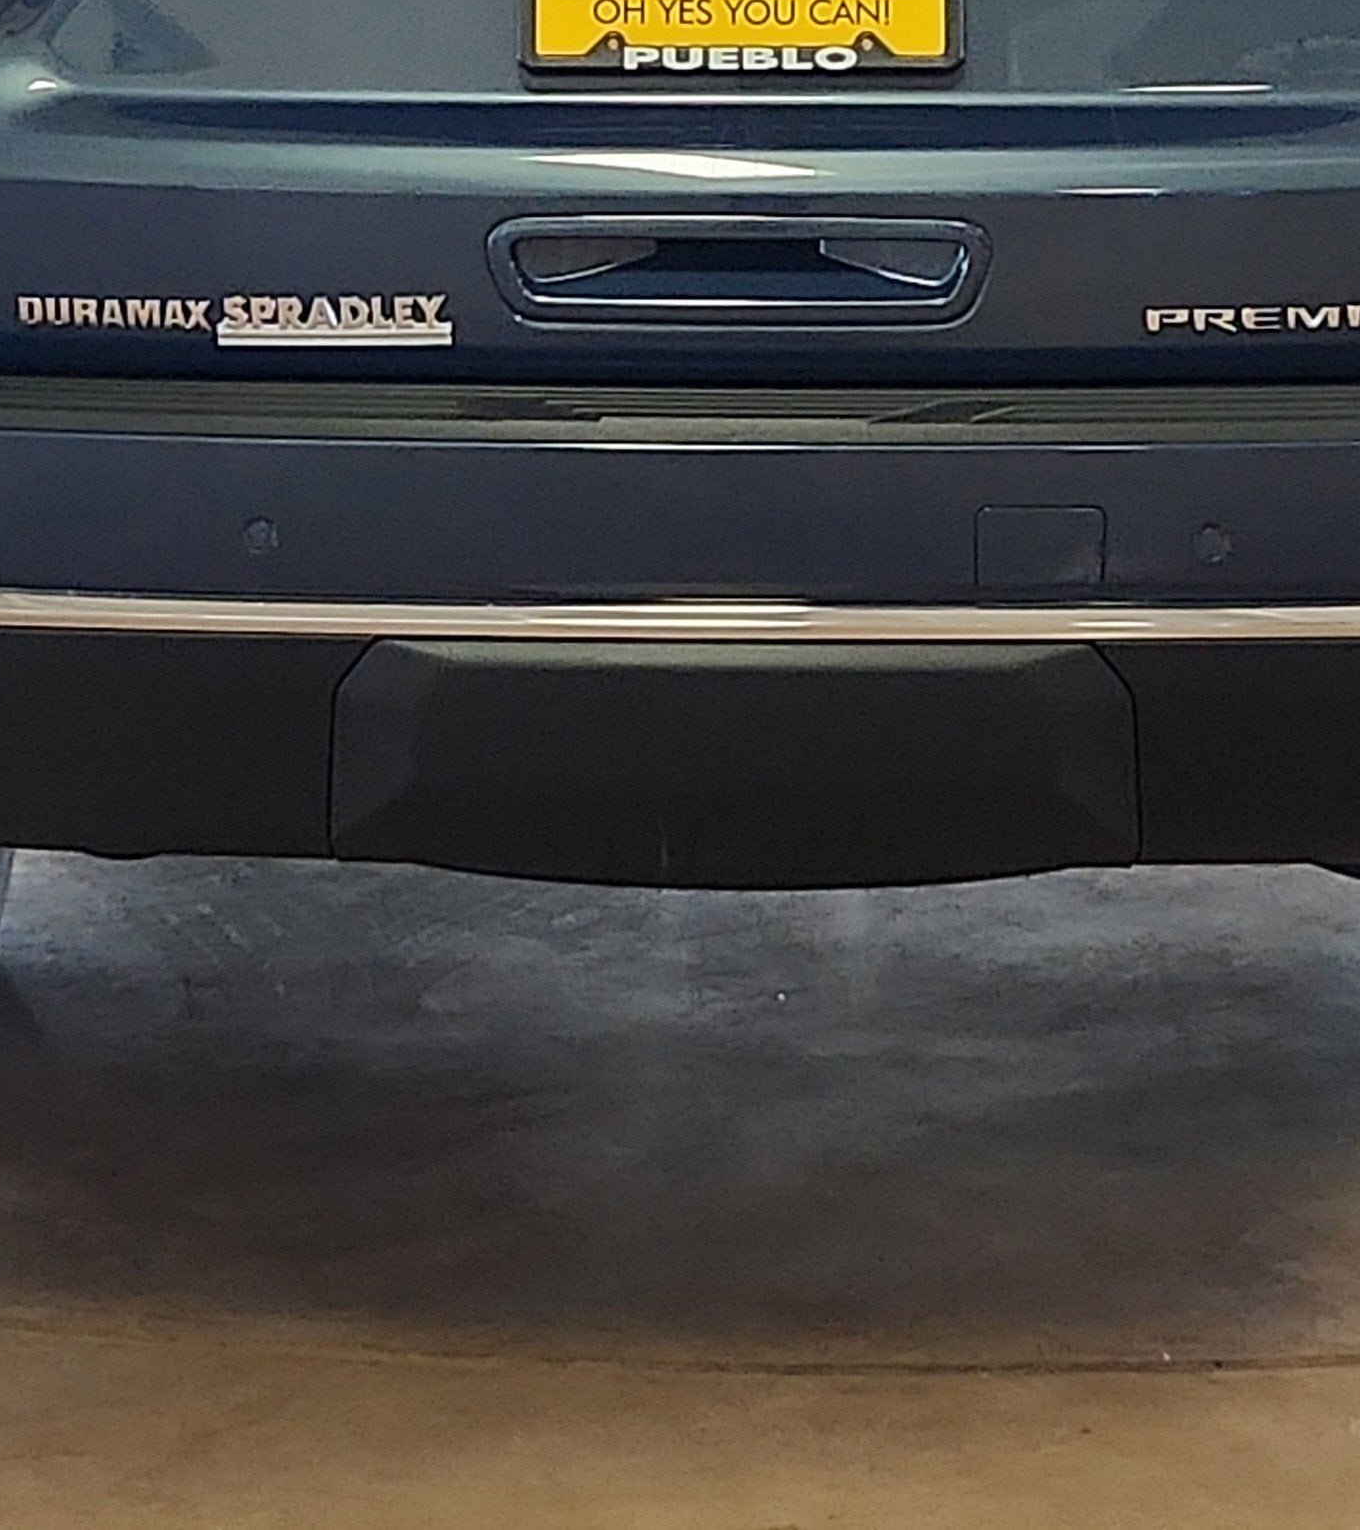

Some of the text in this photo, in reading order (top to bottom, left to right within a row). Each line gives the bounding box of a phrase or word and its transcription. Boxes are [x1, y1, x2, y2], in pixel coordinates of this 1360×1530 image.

[623, 46, 859, 70] PUEBLO
[17, 296, 212, 330] DURAMAX
[221, 294, 447, 330] SPRADLEY
